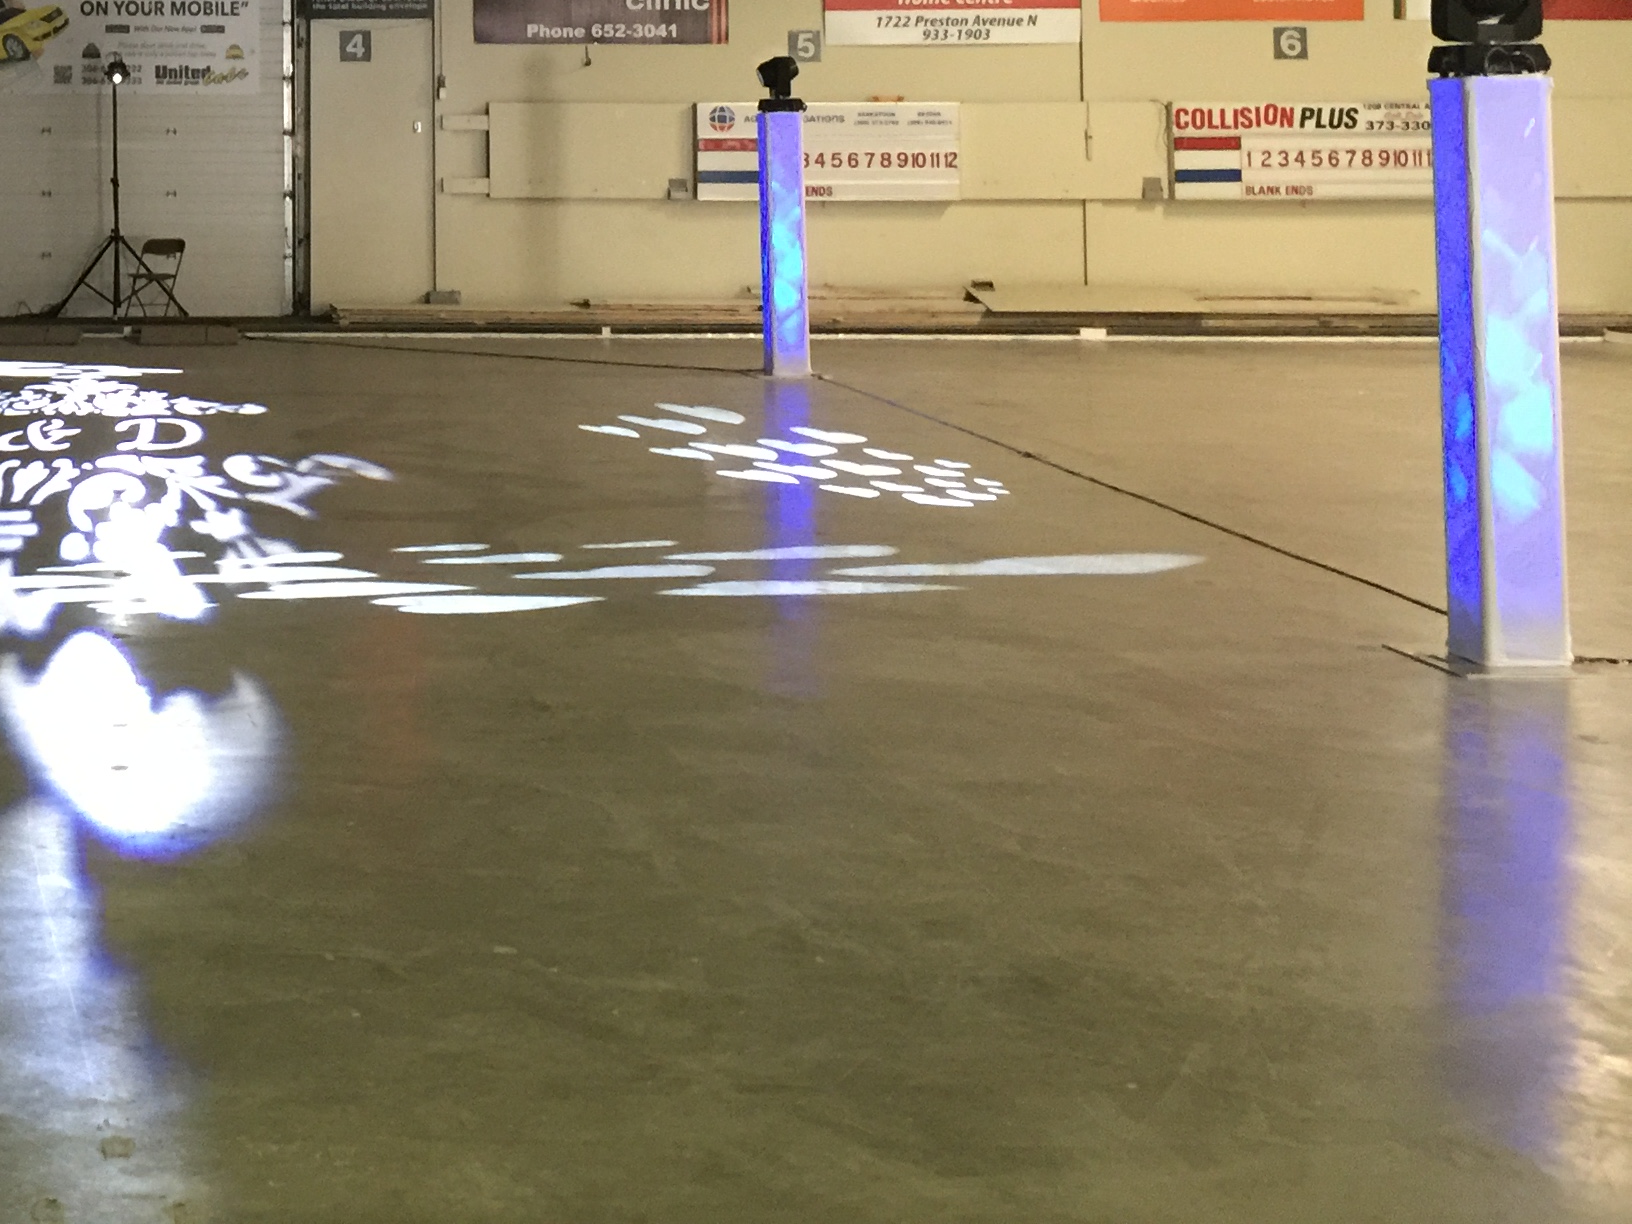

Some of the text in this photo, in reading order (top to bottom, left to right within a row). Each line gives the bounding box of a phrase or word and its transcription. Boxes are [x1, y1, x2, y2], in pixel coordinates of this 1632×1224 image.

[80, 0, 109, 16] ON
[114, 0, 165, 16] YOUR
[876, 14, 1038, 28] 1722 Preston Avenue N
[527, 23, 678, 38] Phone 652-3041
[922, 28, 991, 41] 933-1903
[345, 34, 365, 58] 4
[796, 34, 815, 57] 5
[1280, 30, 1302, 56] 6
[155, 65, 211, 80] United
[1174, 104, 1295, 130] COLLISION
[1299, 107, 1359, 130] PLUS
[815, 152, 825, 169] 4
[831, 152, 842, 169] 5
[848, 152, 858, 169] 6
[865, 152, 875, 169] 7
[880, 152, 892, 169] 8
[897, 152, 908, 169] 9
[911, 152, 926, 169] 10
[930, 152, 939, 169] 11
[944, 152, 957, 169] 12
[1261, 150, 1272, 168] 2
[1278, 150, 1289, 168] 3
[1295, 150, 1306, 168] 4
[1312, 150, 1323, 168] 5
[1328, 150, 1339, 168] 6
[1345, 150, 1356, 168] 7
[1362, 150, 1373, 168] 8
[1379, 150, 1390, 168] 9
[1393, 150, 1408, 168] 10
[1413, 150, 1422, 168] 11
[805, 186, 833, 197] ENDS
[1245, 185, 1313, 196] BLANK ENDS
[115, 417, 204, 452] D
